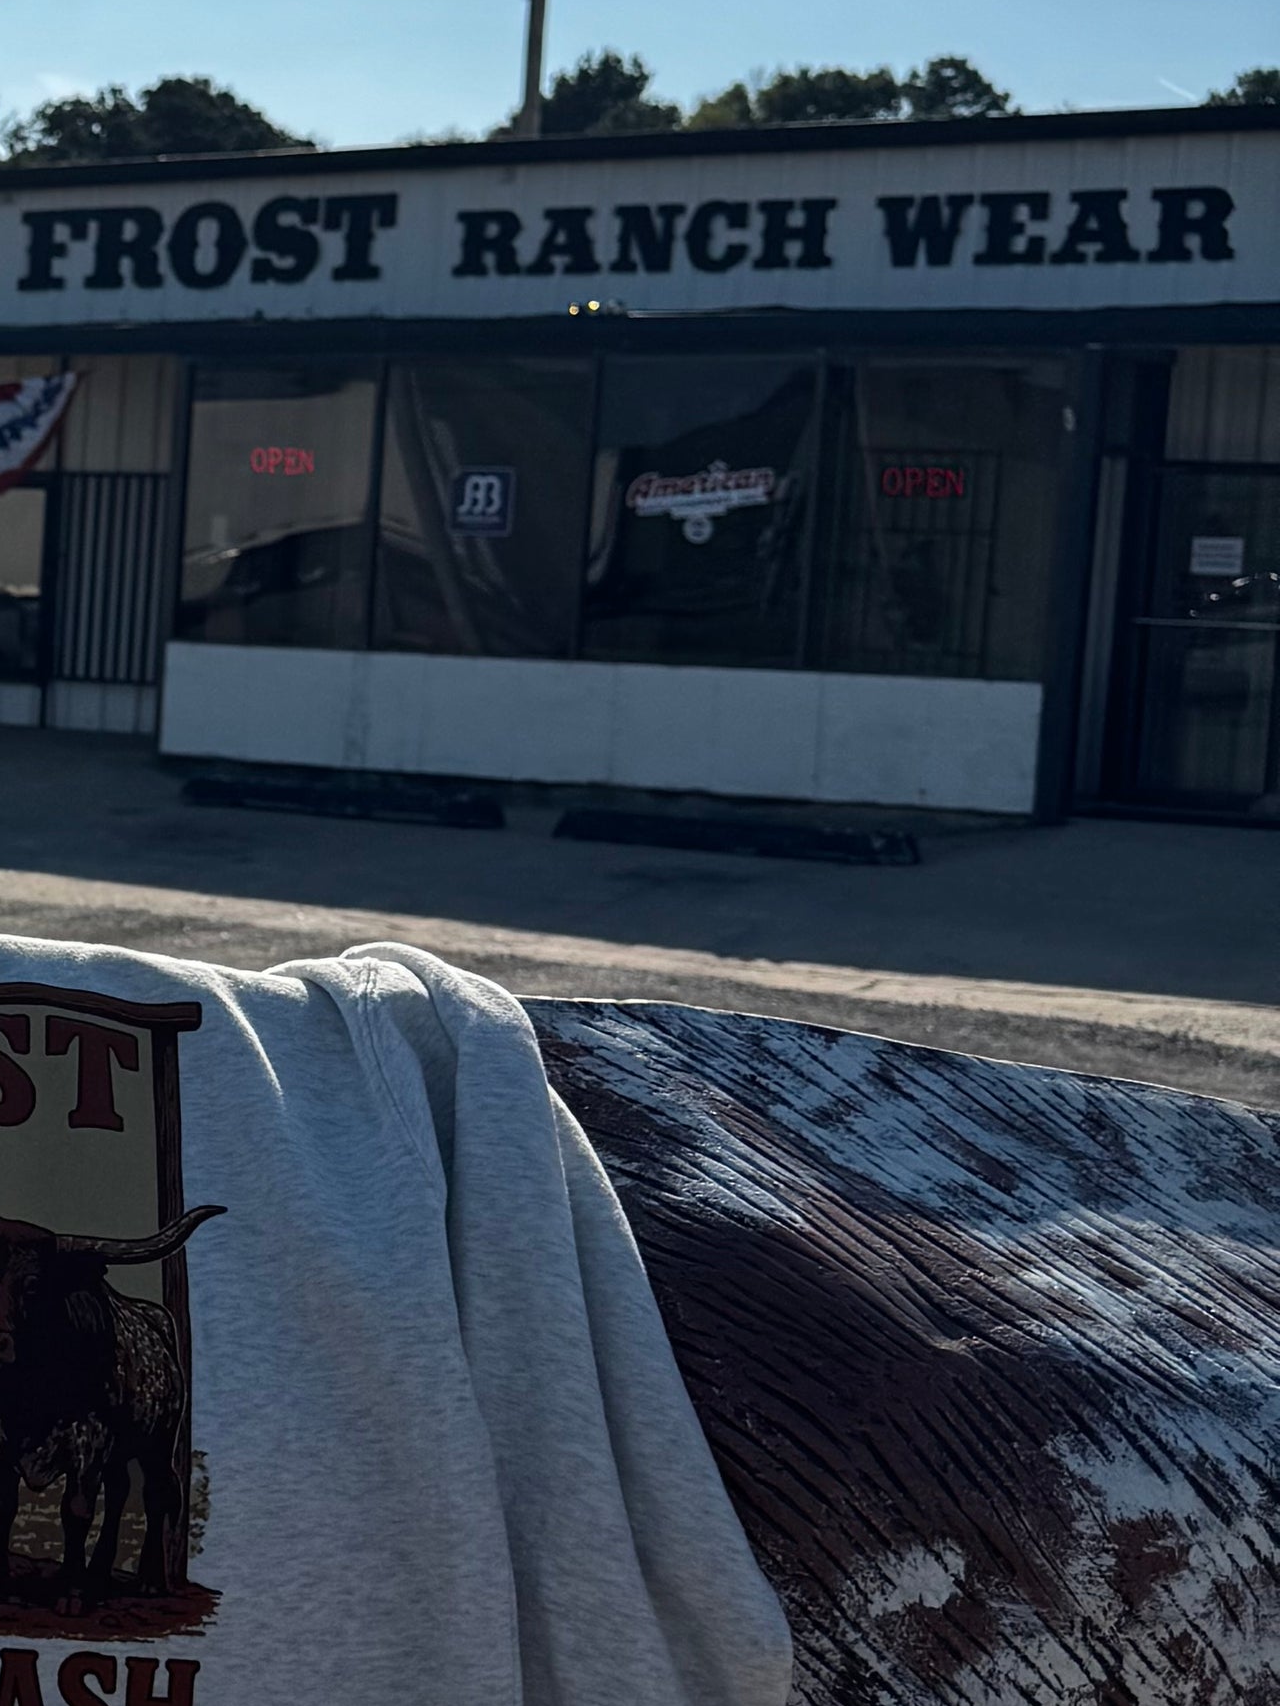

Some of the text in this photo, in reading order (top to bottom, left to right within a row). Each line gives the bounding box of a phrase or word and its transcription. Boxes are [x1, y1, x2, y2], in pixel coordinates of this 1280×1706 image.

[17, 186, 1236, 292] FROST RANCH WEAR
[250, 446, 316, 476] OPEN
[882, 466, 965, 498] OPEN
